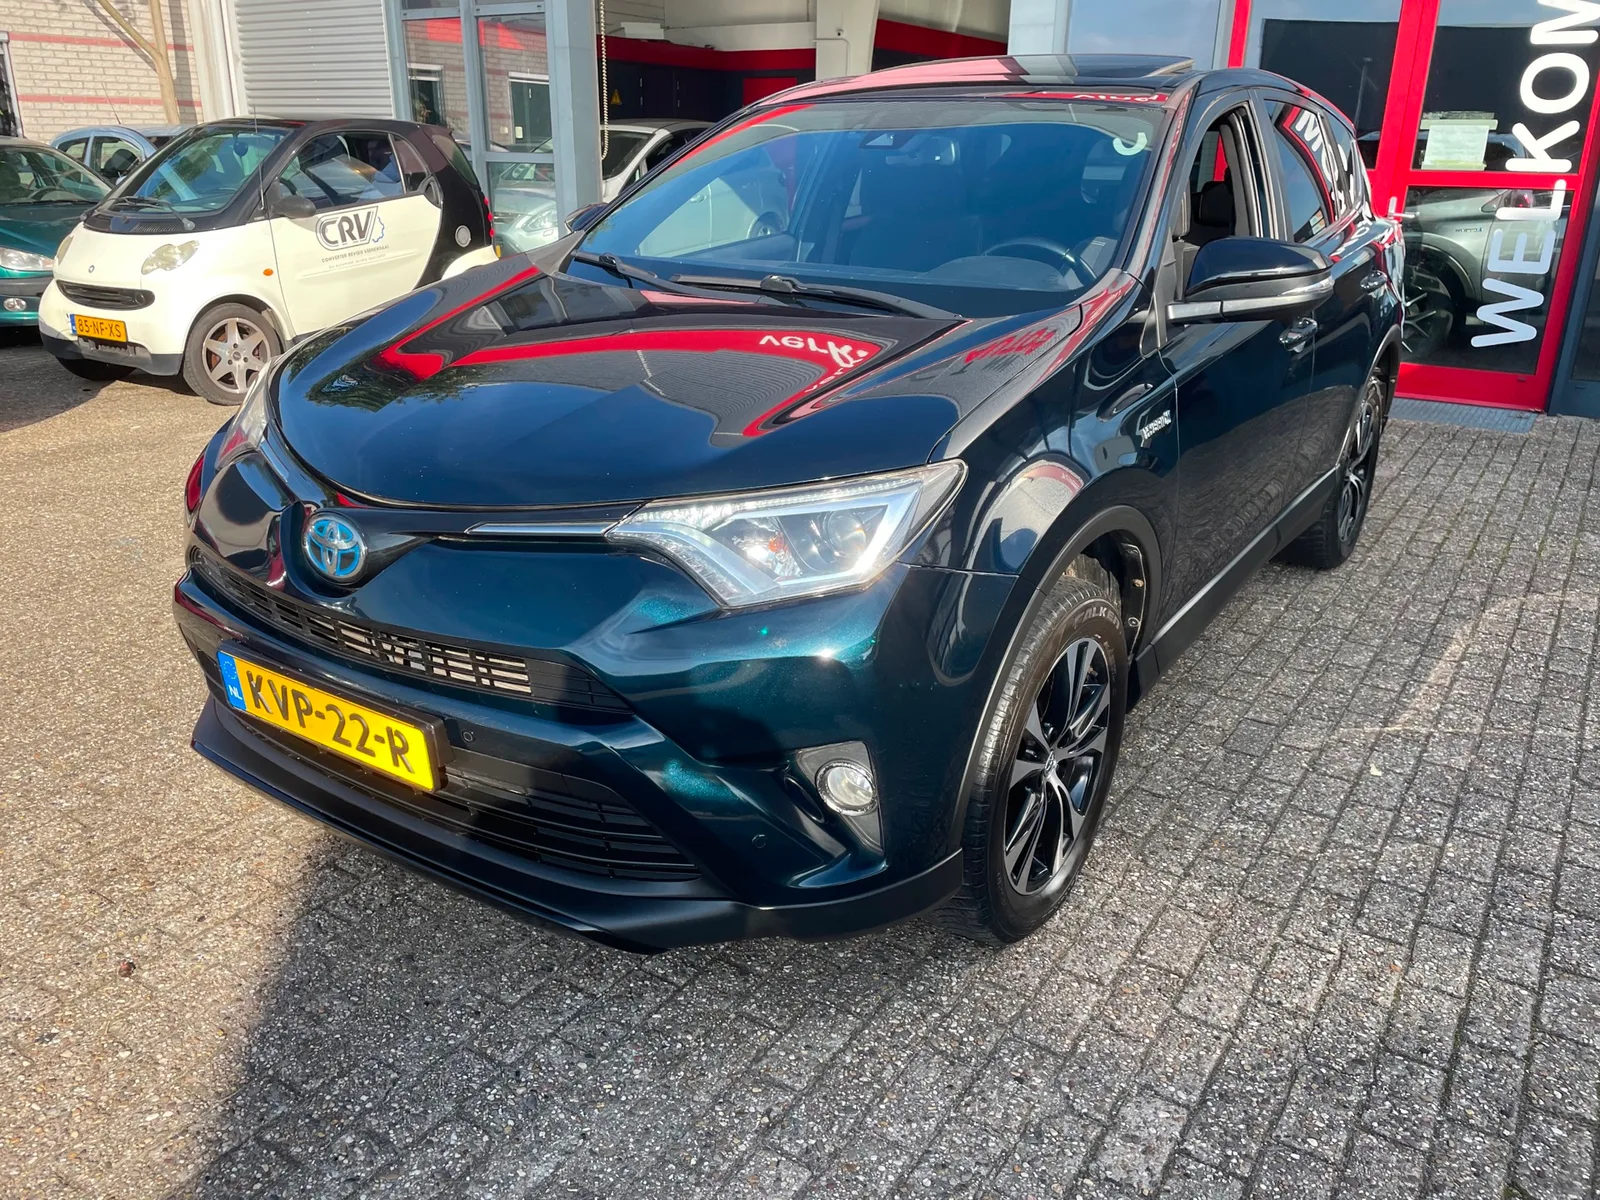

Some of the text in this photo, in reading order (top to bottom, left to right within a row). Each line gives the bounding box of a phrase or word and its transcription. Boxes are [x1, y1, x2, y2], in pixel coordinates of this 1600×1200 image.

[320, 210, 373, 245] CRV
[78, 318, 122, 338] 85-NF-XS
[1072, 606, 1120, 630] FALKEN
[228, 684, 243, 700] NL
[246, 670, 415, 774] KVP-22-R
